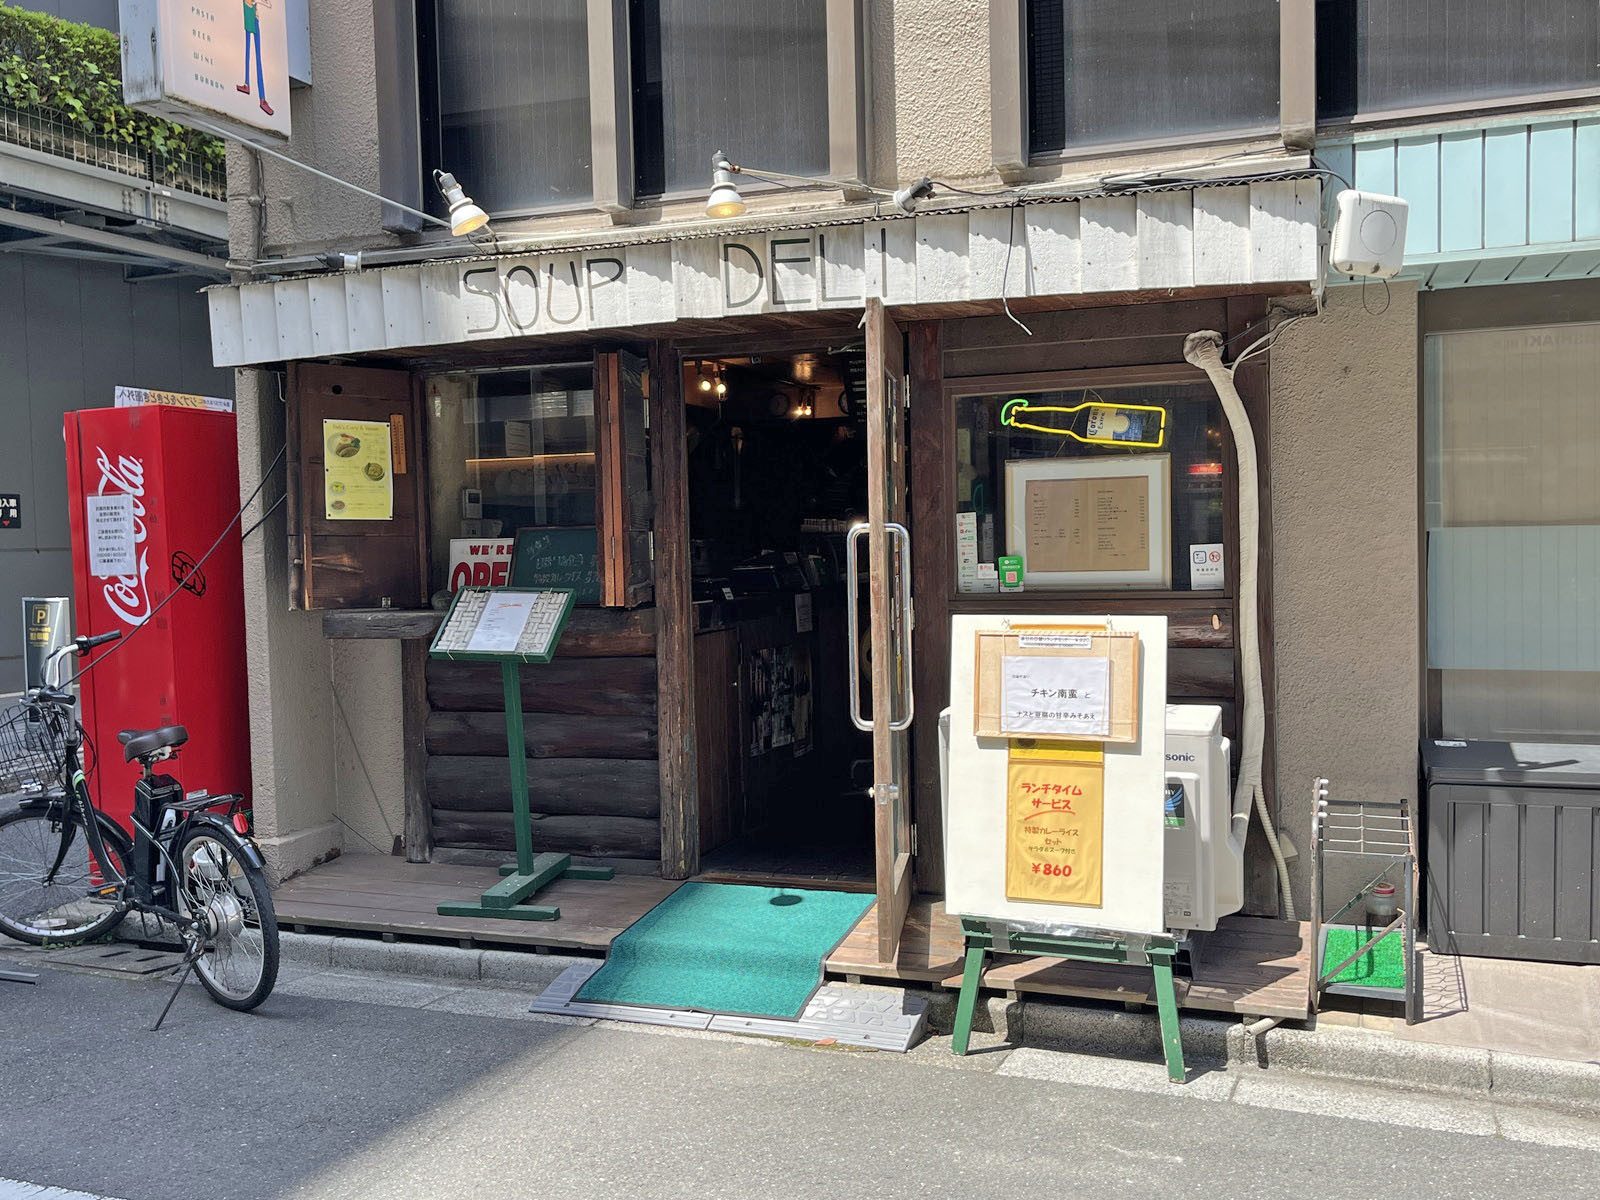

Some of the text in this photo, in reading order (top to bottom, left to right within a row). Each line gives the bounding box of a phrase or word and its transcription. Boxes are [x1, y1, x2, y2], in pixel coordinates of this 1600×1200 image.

[462, 227, 887, 335] SOUP DELI
[1088, 408, 1100, 436] Corona
[0, 498, 17, 508] 入車
[469, 545, 513, 555] WE'RE
[451, 562, 509, 594] OPE
[37, 609, 46, 624] P
[1031, 688, 1077, 699] チキン南蛮
[1016, 710, 1096, 720] ナスと豆腐の甘辛みそあえ
[1165, 753, 1196, 762] sonic
[1021, 783, 1083, 796] ランチタイム
[1031, 798, 1072, 810] サービス
[1024, 826, 1079, 837] 特製カレーライス
[1045, 838, 1062, 846] セット
[1031, 862, 1072, 877] ¥860
